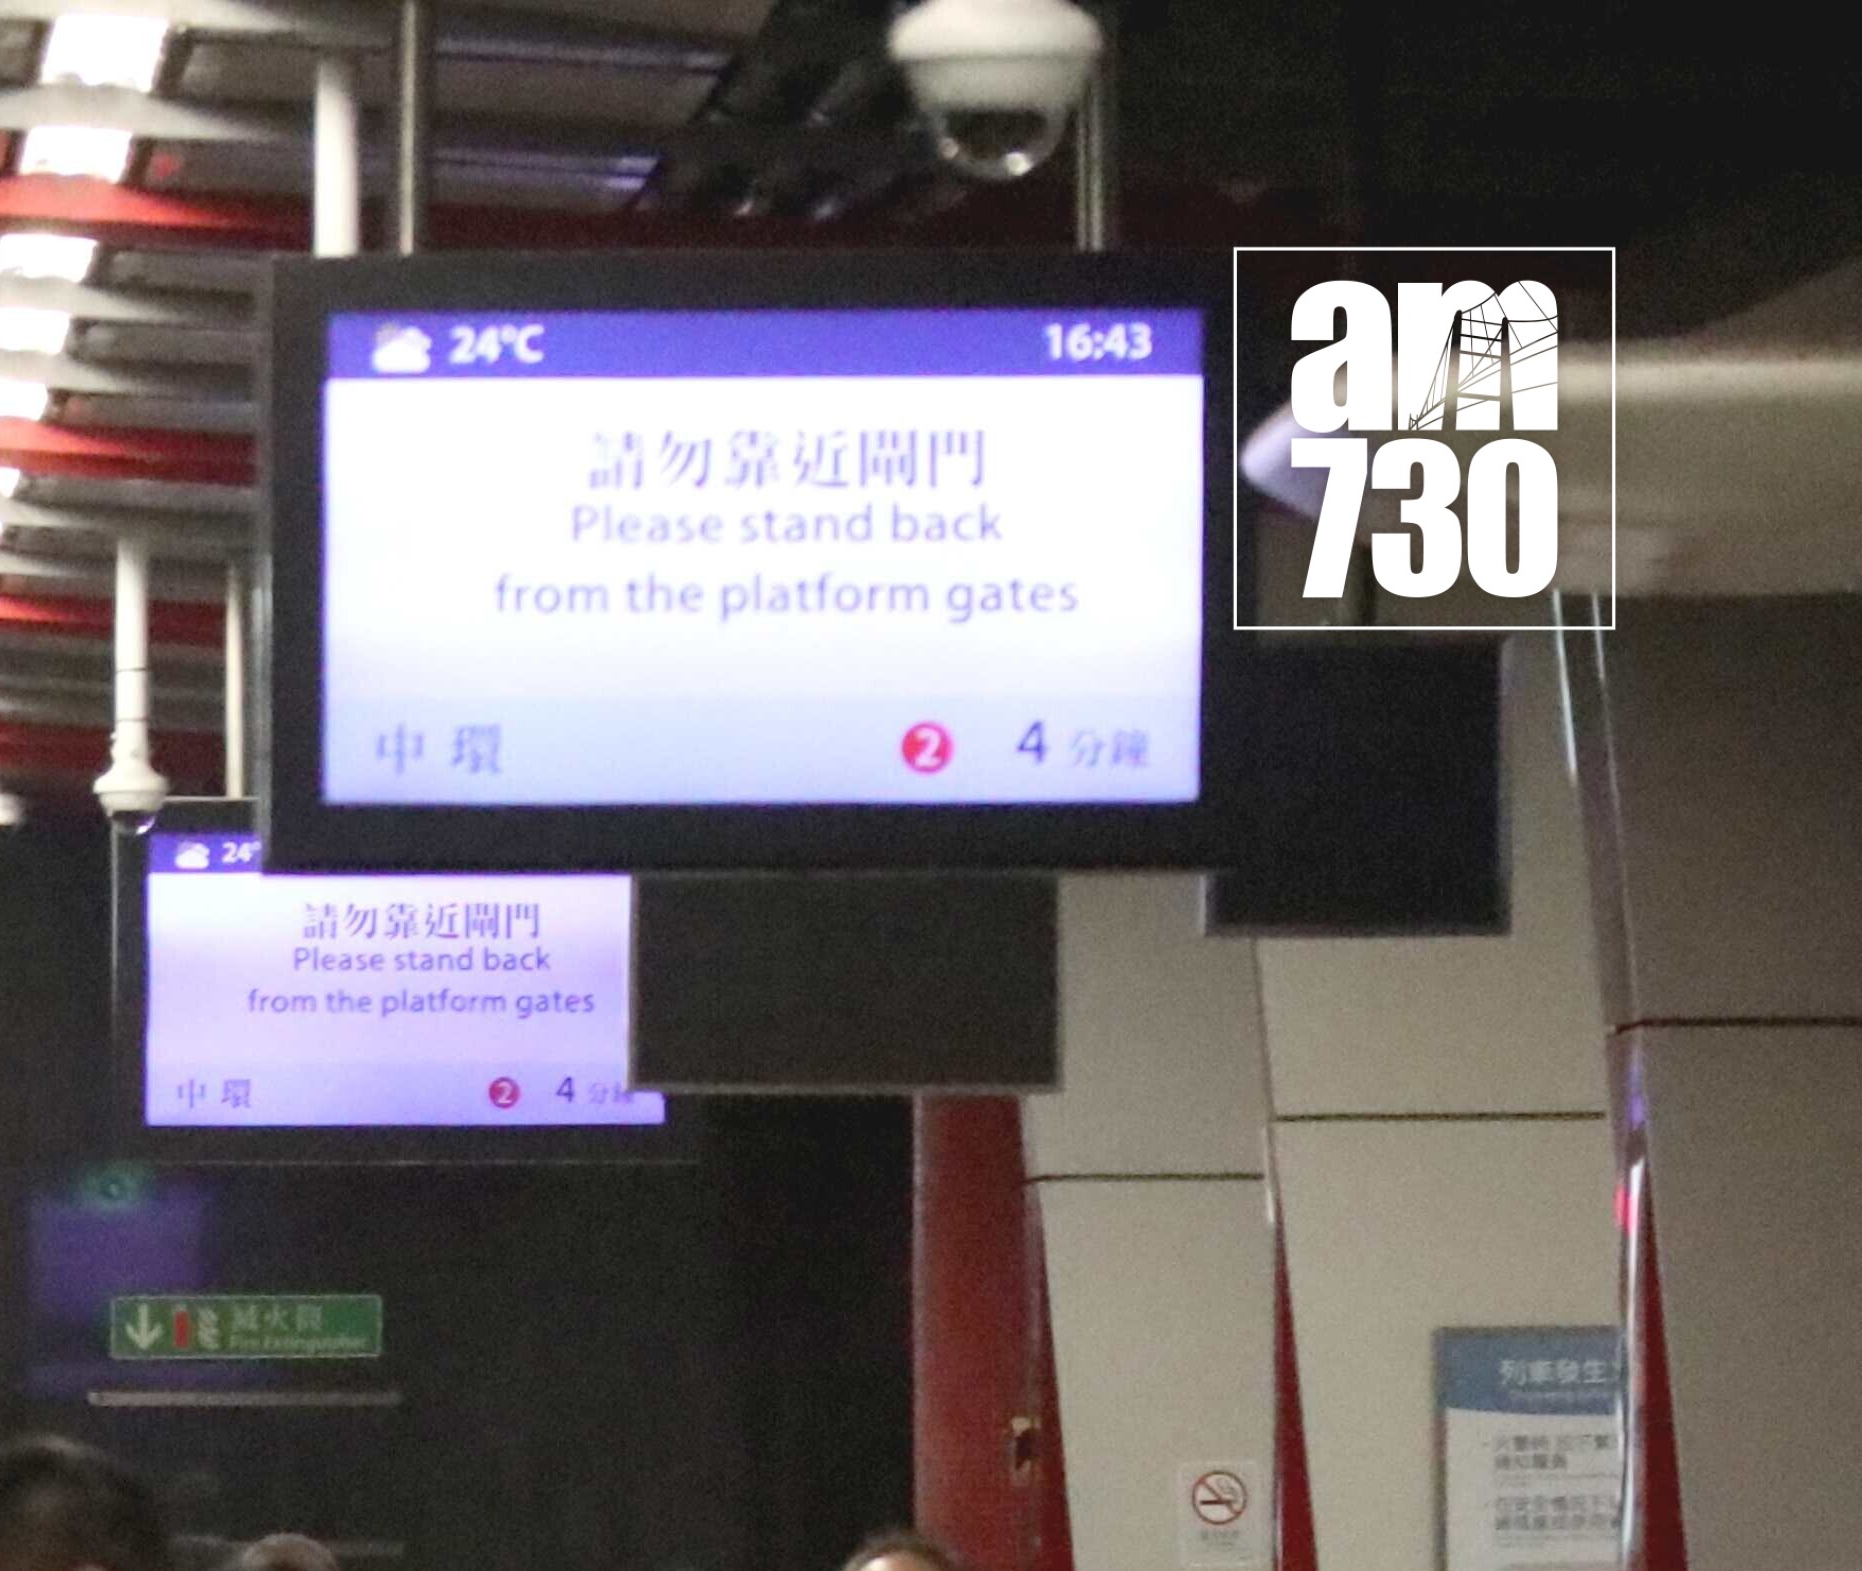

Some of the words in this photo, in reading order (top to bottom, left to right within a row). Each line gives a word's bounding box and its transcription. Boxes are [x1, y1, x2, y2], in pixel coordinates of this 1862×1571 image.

[1044, 321, 1153, 362] 16:43
[588, 428, 986, 491] 請勿靠近閘門
[571, 504, 724, 544] Please
[740, 502, 873, 543] stand
[890, 503, 1003, 543] back
[494, 573, 609, 615] from
[625, 574, 704, 614] the
[719, 572, 931, 624] platform
[945, 579, 1078, 625] gates
[1016, 720, 1049, 764] 4
[301, 902, 543, 941] 請勿靠近閘門
[292, 946, 386, 973] Please
[393, 946, 475, 973] stand
[482, 946, 552, 973] back
[247, 987, 318, 1014] from
[324, 988, 373, 1014] the
[380, 987, 508, 1019] platform
[514, 991, 596, 1021] gates
[555, 1076, 576, 1103] 4
